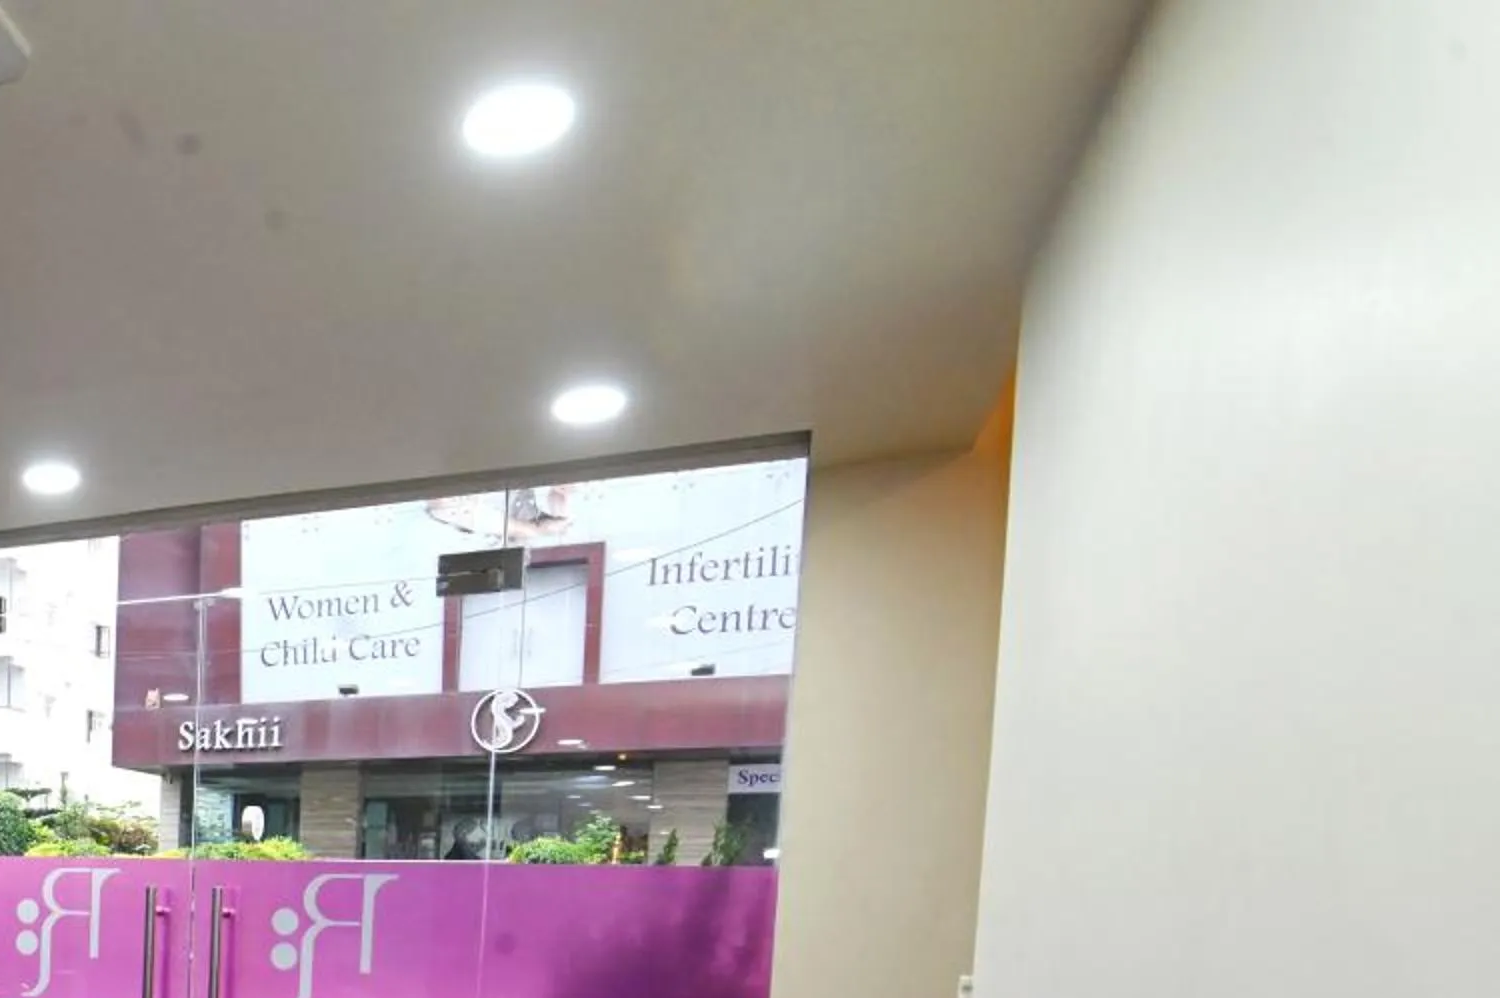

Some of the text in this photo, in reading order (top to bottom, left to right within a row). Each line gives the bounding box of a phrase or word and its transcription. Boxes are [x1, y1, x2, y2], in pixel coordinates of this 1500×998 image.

[647, 545, 802, 586] Infertili
[268, 579, 414, 620] Women &
[669, 604, 797, 635] Centre
[260, 634, 421, 668] Child Care
[177, 716, 285, 751] Sakhii
